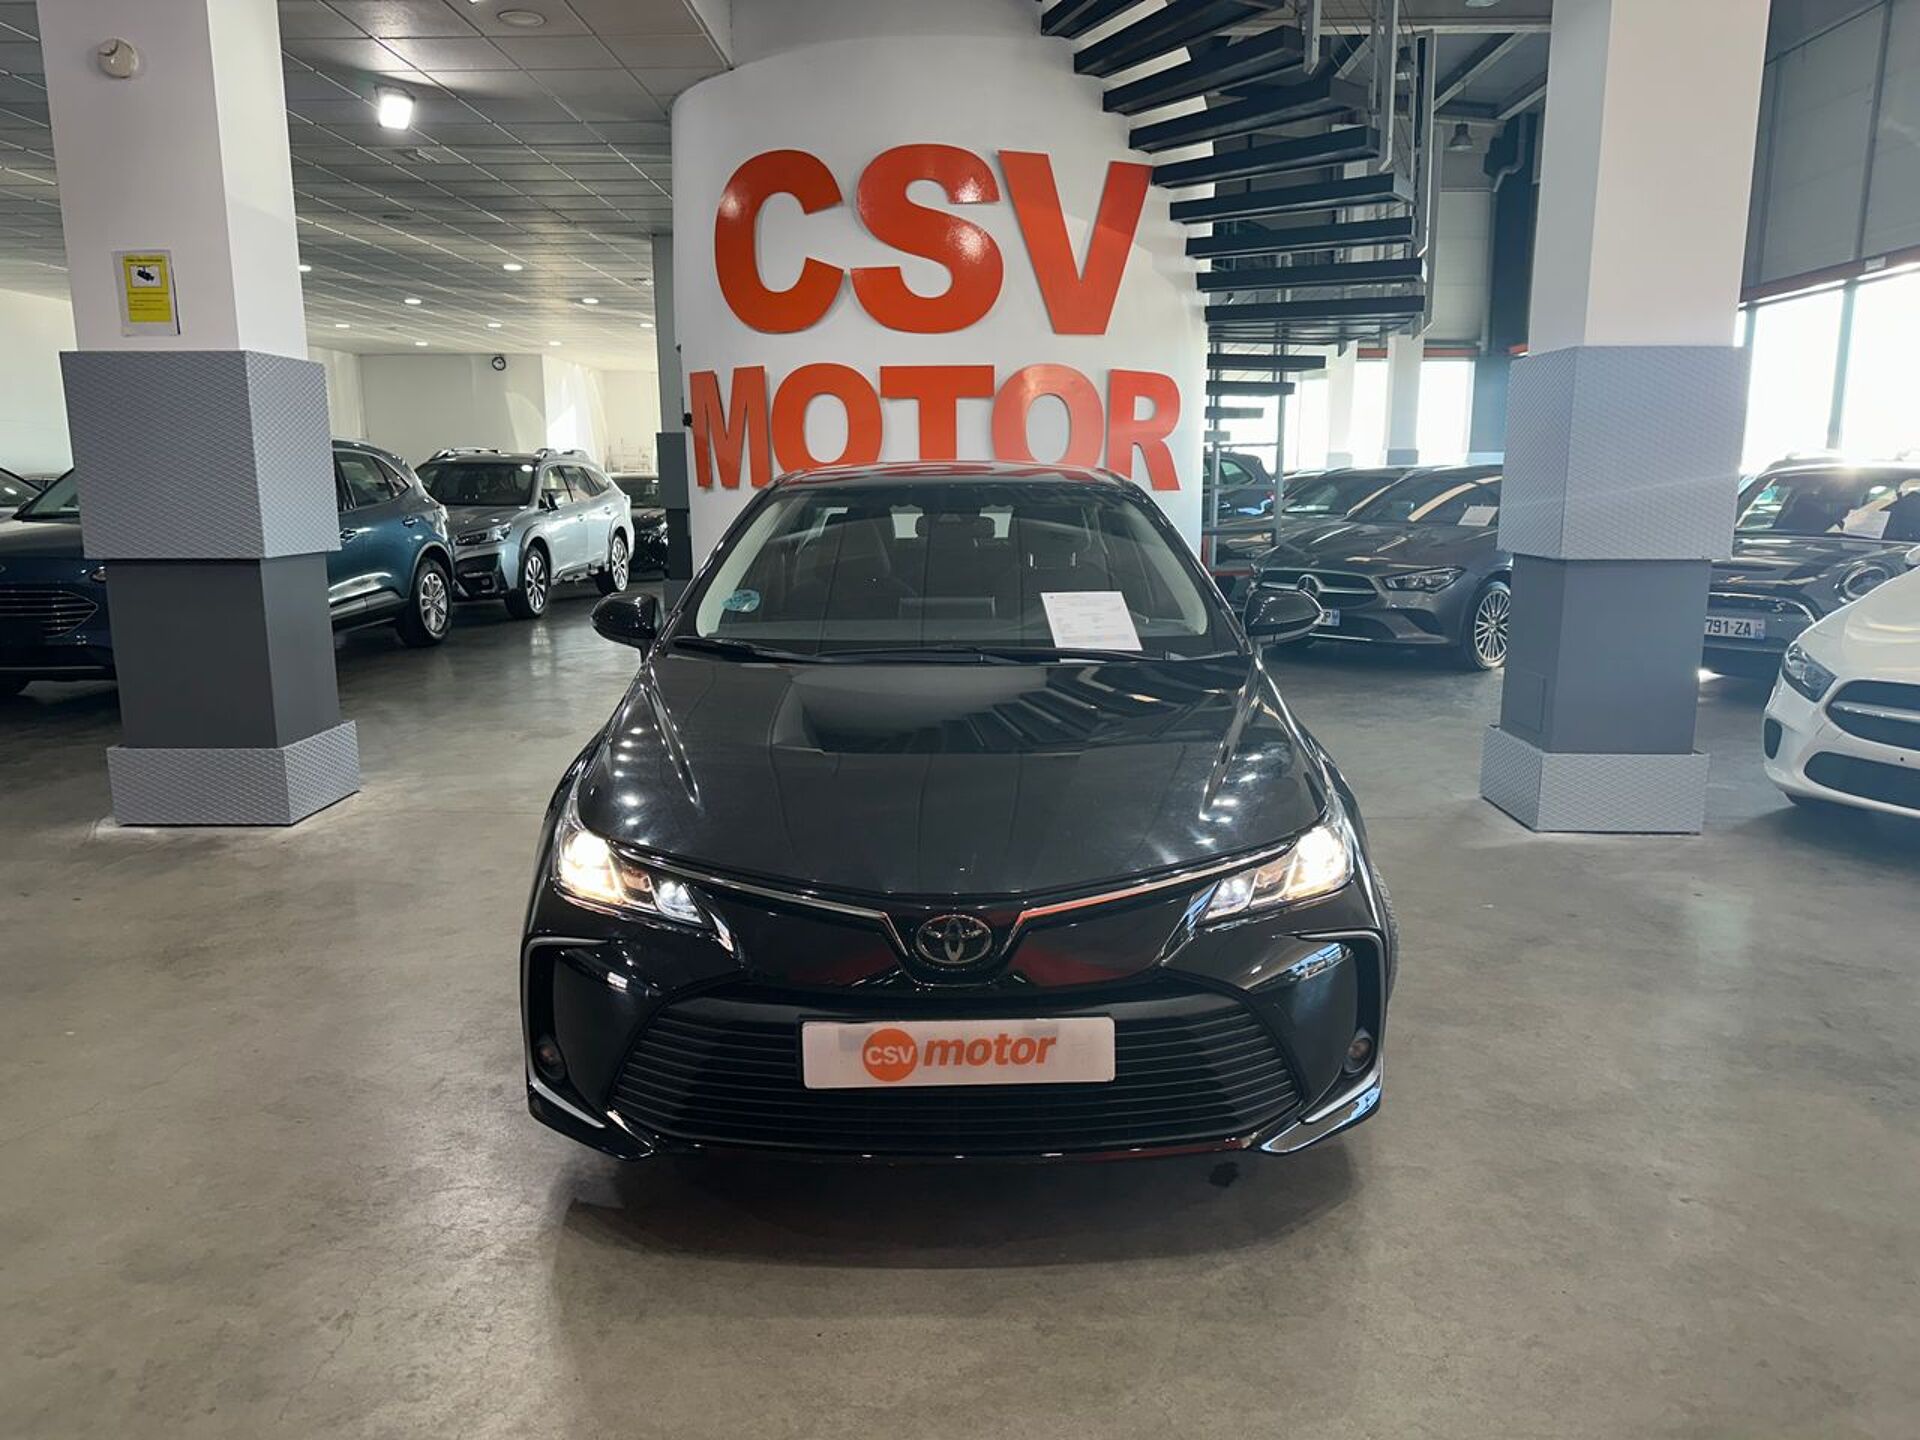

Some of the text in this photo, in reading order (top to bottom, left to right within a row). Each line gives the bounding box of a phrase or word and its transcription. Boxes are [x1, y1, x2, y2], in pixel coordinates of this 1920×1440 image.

[714, 143, 1153, 335] CSV
[690, 362, 1181, 490] MOTOR
[1706, 619, 1751, 636] 791-ZA
[923, 1033, 1056, 1066] motor
